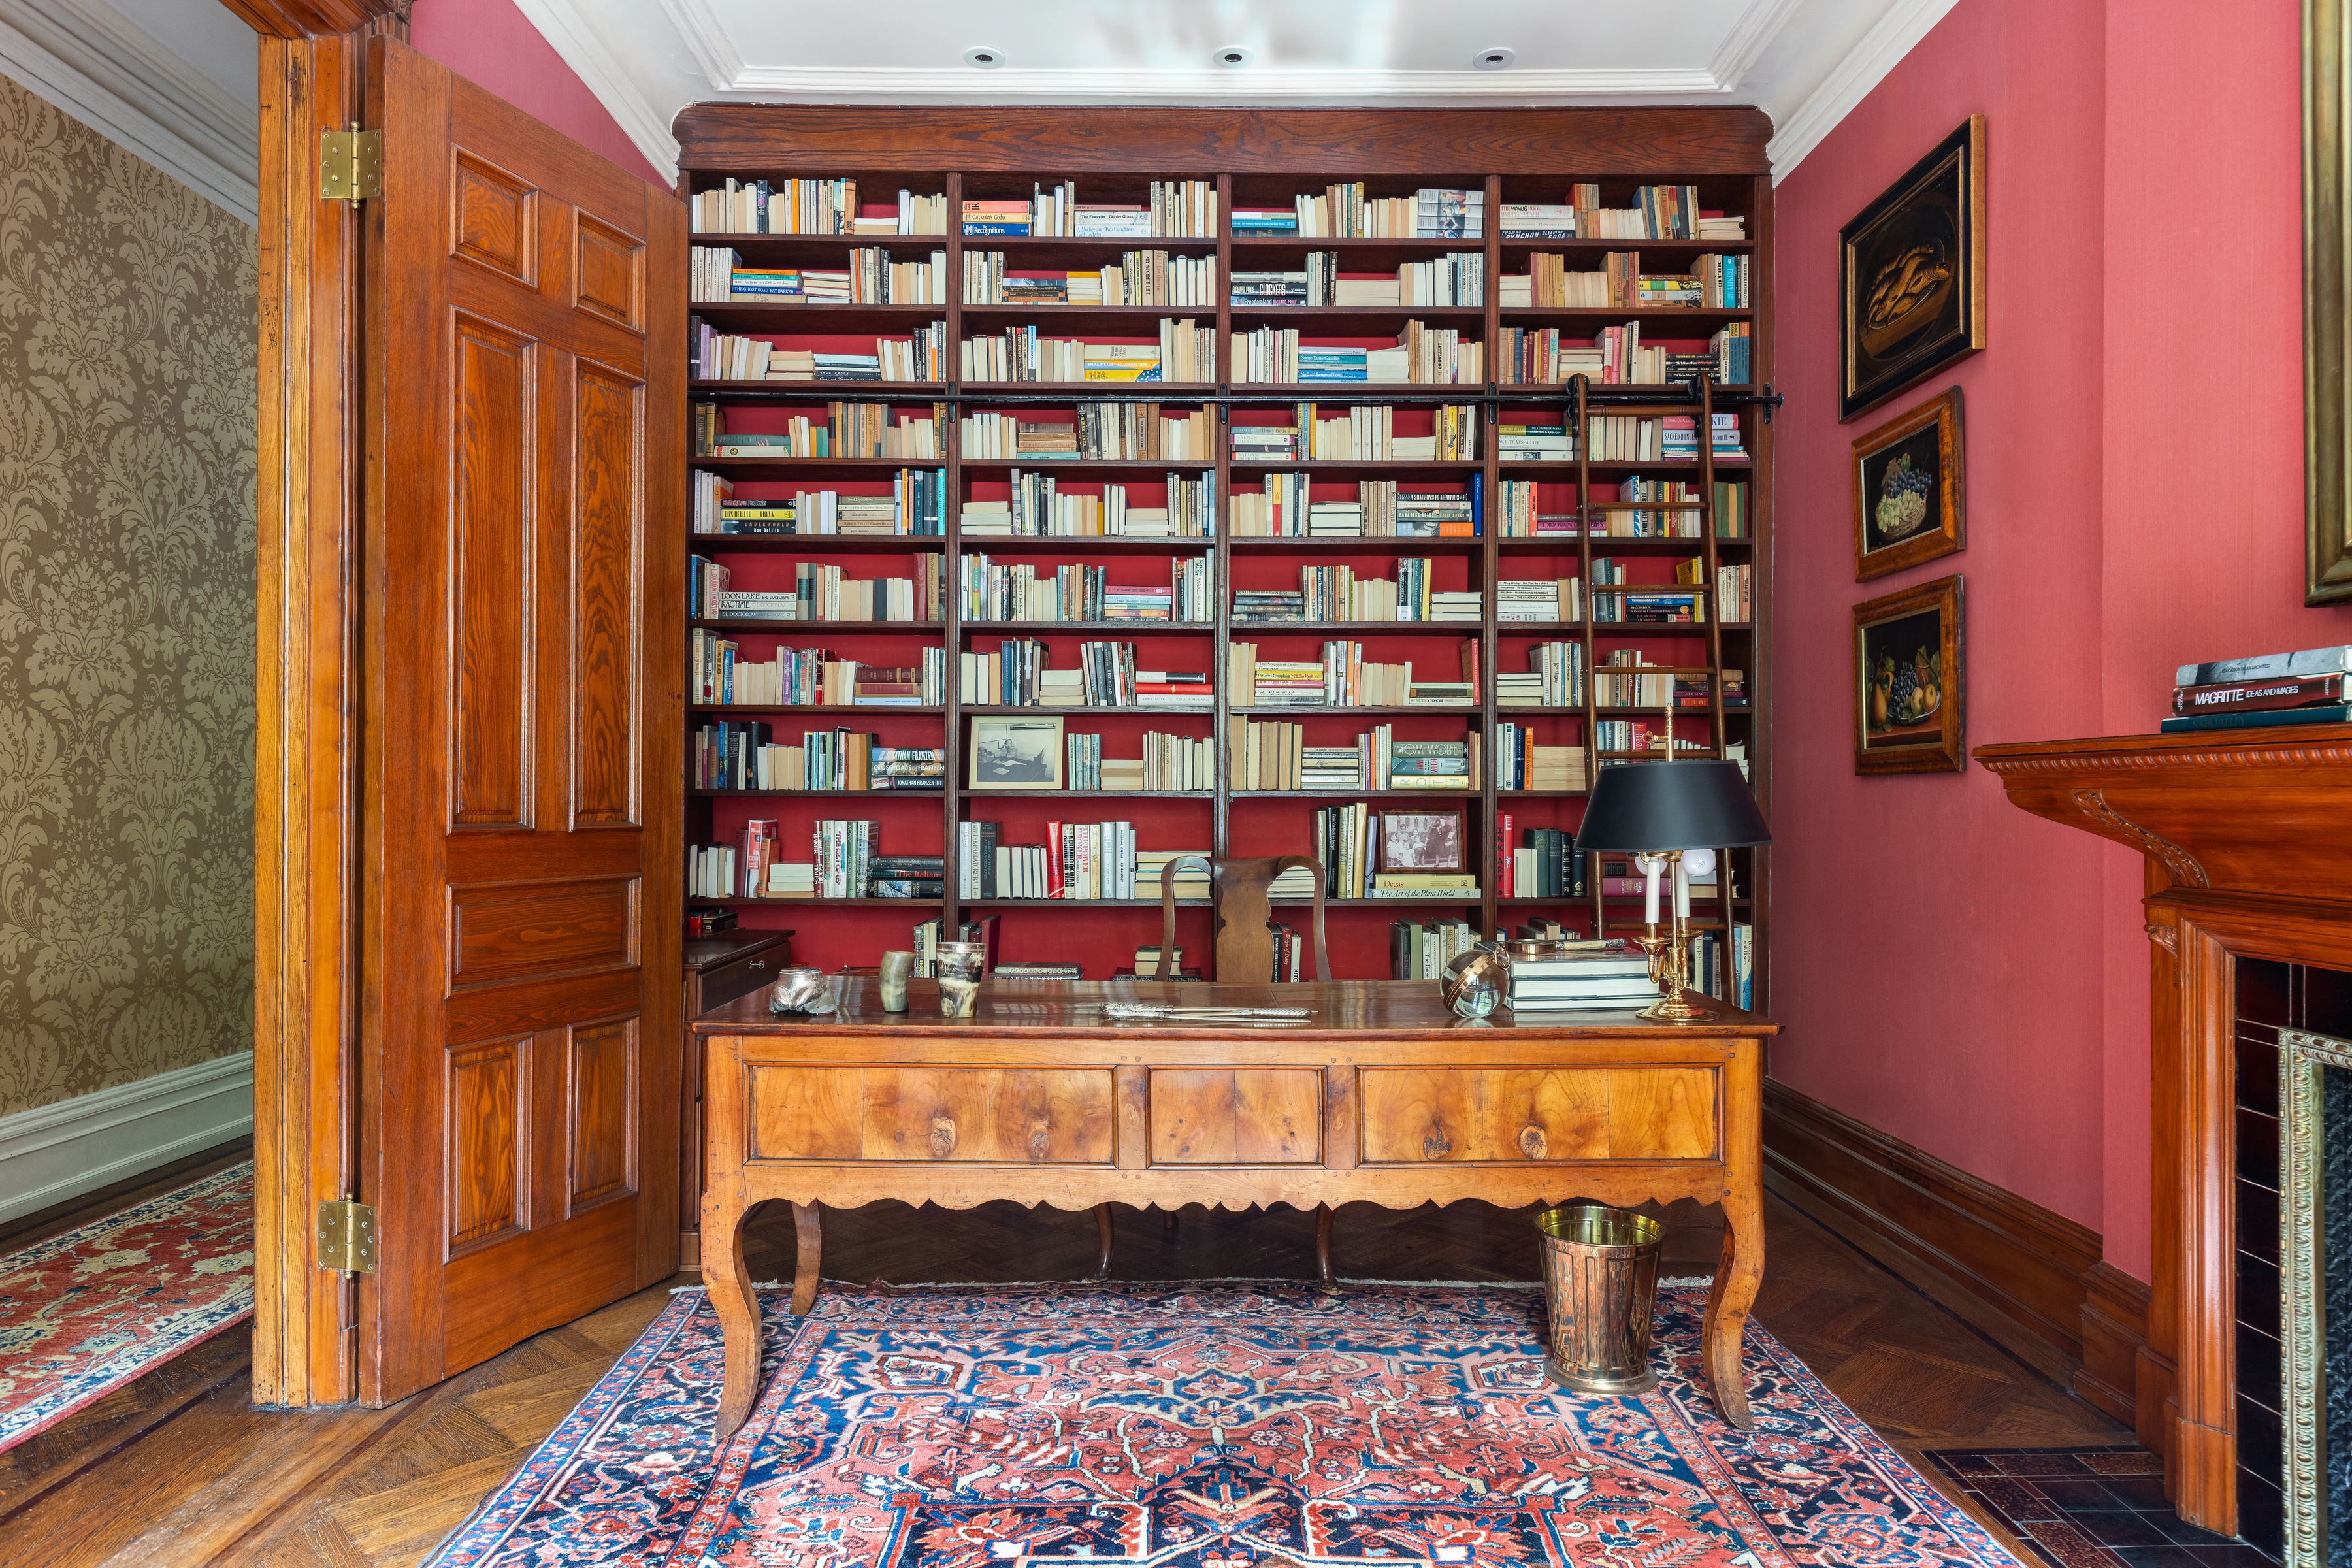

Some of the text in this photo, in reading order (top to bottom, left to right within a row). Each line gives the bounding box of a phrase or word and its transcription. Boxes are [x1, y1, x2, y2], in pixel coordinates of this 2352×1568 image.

[1259, 284, 1286, 296] CLOCKERS
[2195, 685, 2298, 705] MAGRITTE IDEAS AND IMAGES
[1401, 744, 1458, 755] TOM WOLFE
[885, 750, 936, 761] JONATHAN FRANZEN
[1064, 840, 1075, 863] RUMOR
[1064, 863, 1075, 872] OF
[1064, 872, 1075, 887] WAR
[1383, 879, 1403, 888] Degas
[1436, 889, 1455, 897] World
